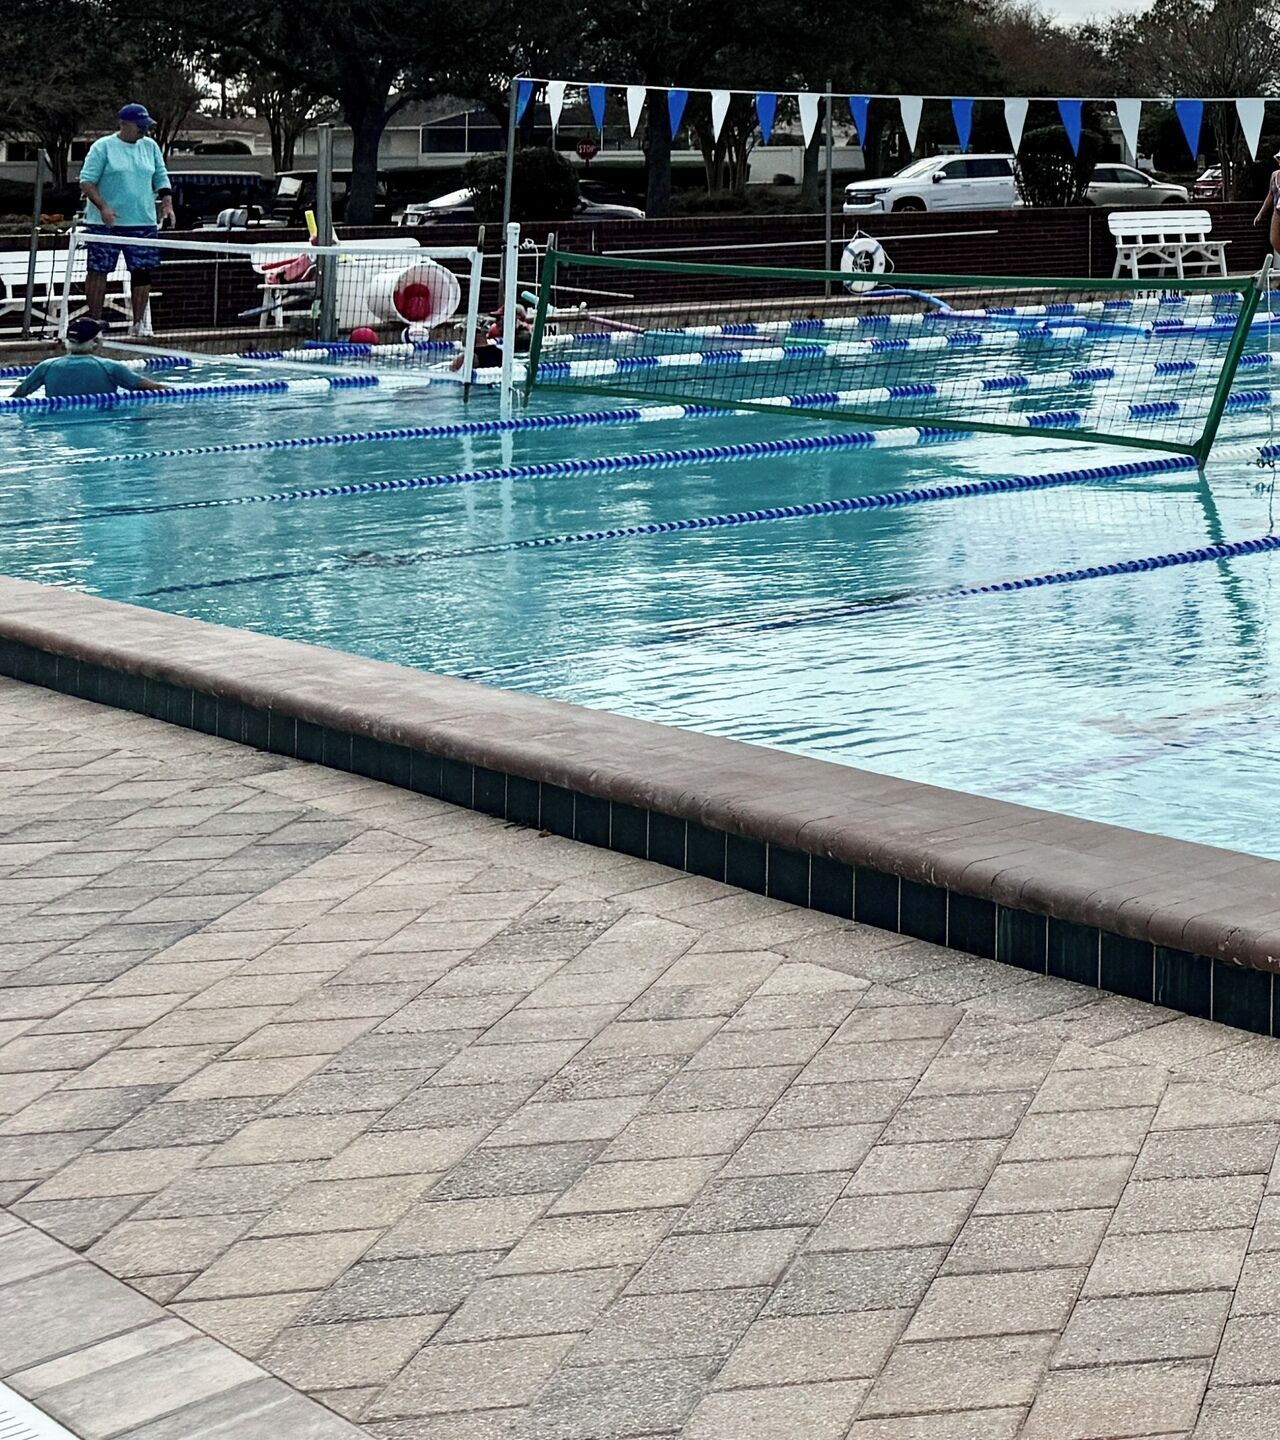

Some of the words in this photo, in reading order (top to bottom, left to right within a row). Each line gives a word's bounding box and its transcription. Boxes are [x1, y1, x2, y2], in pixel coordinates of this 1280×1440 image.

[578, 145, 597, 153] STOP
[1147, 290, 1157, 299] FT
[544, 325, 556, 336] IN
